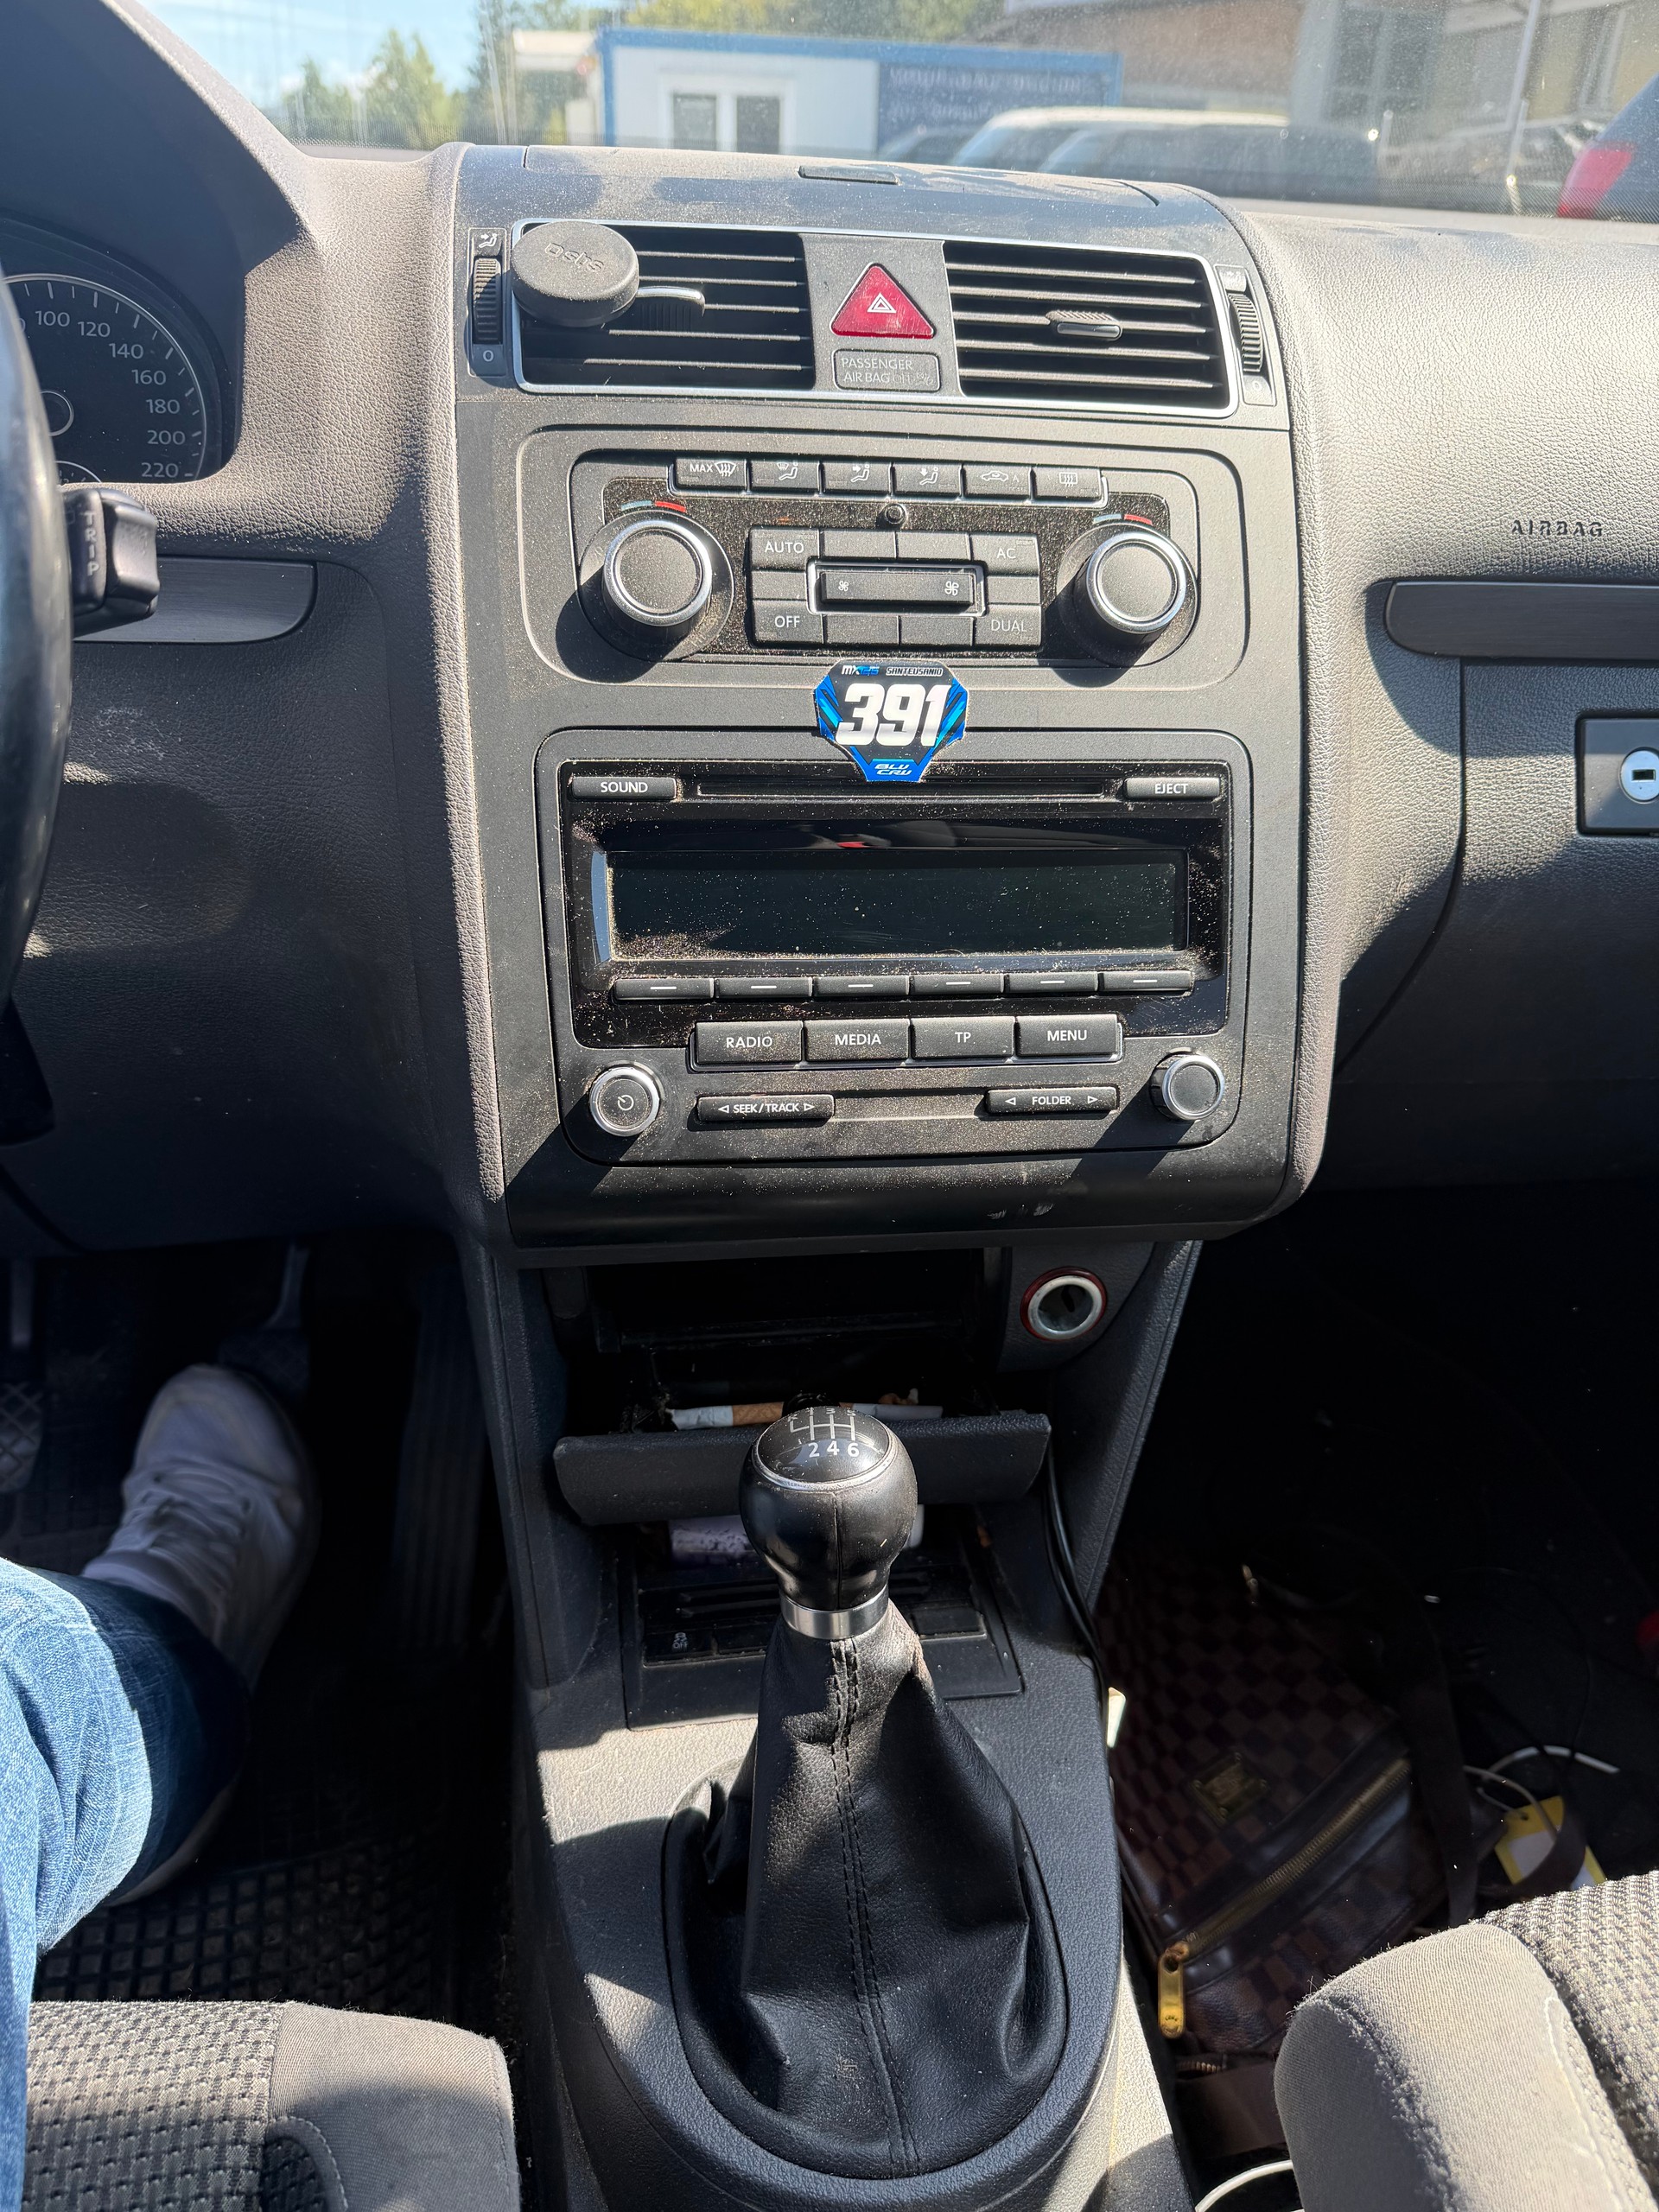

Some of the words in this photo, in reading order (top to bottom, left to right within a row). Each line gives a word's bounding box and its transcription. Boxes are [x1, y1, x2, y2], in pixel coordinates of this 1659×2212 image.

[35, 310, 70, 327] 100
[77, 321, 111, 338] 120
[108, 342, 144, 359] 140
[841, 357, 913, 371] PASSENGER
[131, 369, 167, 385] 160
[843, 372, 862, 382] AIR
[865, 372, 890, 384] BAG
[145, 398, 180, 415] 180
[147, 429, 186, 445] 200
[141, 461, 179, 478] 220
[689, 463, 714, 474] MAX
[1511, 519, 1602, 537] AIRBAG
[83, 510, 99, 576] TRIP
[764, 541, 804, 554] AUTO
[996, 548, 1016, 560] AC
[774, 615, 800, 628] OFF
[990, 619, 1027, 632] DUAL
[886, 666, 944, 677] SANTEUSANIO
[835, 683, 951, 747] 391
[600, 781, 649, 793] SOUND
[1154, 783, 1189, 794] EJECT
[834, 1033, 882, 1046] MEDIA
[954, 1031, 971, 1043] TP
[1046, 1029, 1088, 1042] MENU
[725, 1036, 773, 1049] RADIO
[1032, 1095, 1071, 1106] FOLDER
[808, 1442, 820, 1458] 2
[826, 1440, 840, 1456] 4
[847, 1442, 860, 1458] 6
